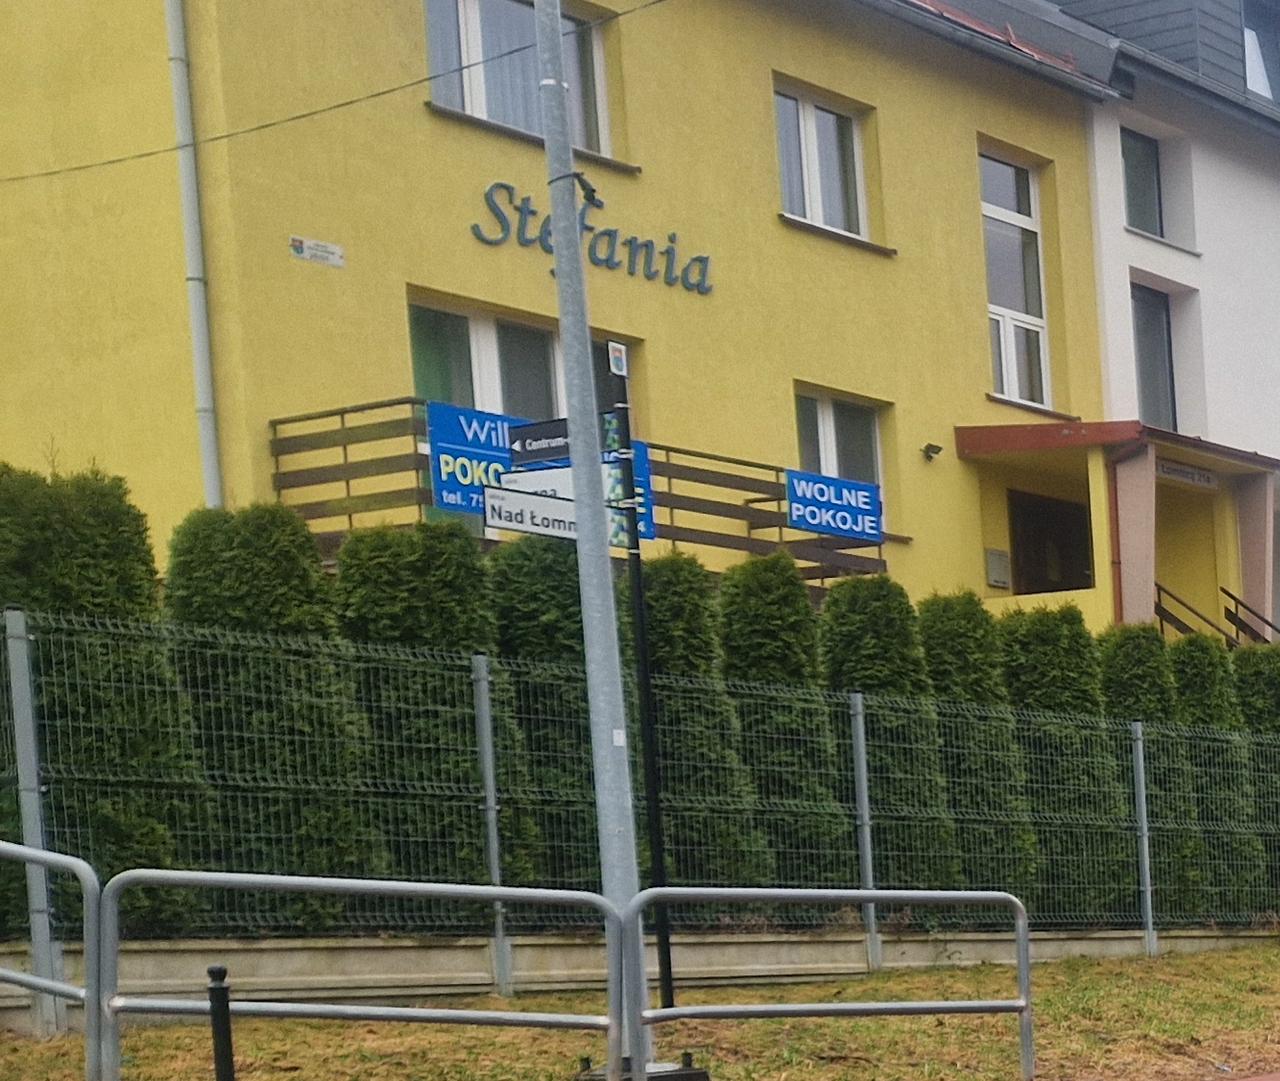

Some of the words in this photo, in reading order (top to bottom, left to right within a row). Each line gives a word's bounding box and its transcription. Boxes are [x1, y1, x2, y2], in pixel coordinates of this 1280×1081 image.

[442, 490, 467, 506] tel.
[792, 479, 872, 510] WOLNE
[490, 504, 524, 524] Nad
[529, 510, 577, 532] Łomn
[791, 502, 878, 534] POKOJE
